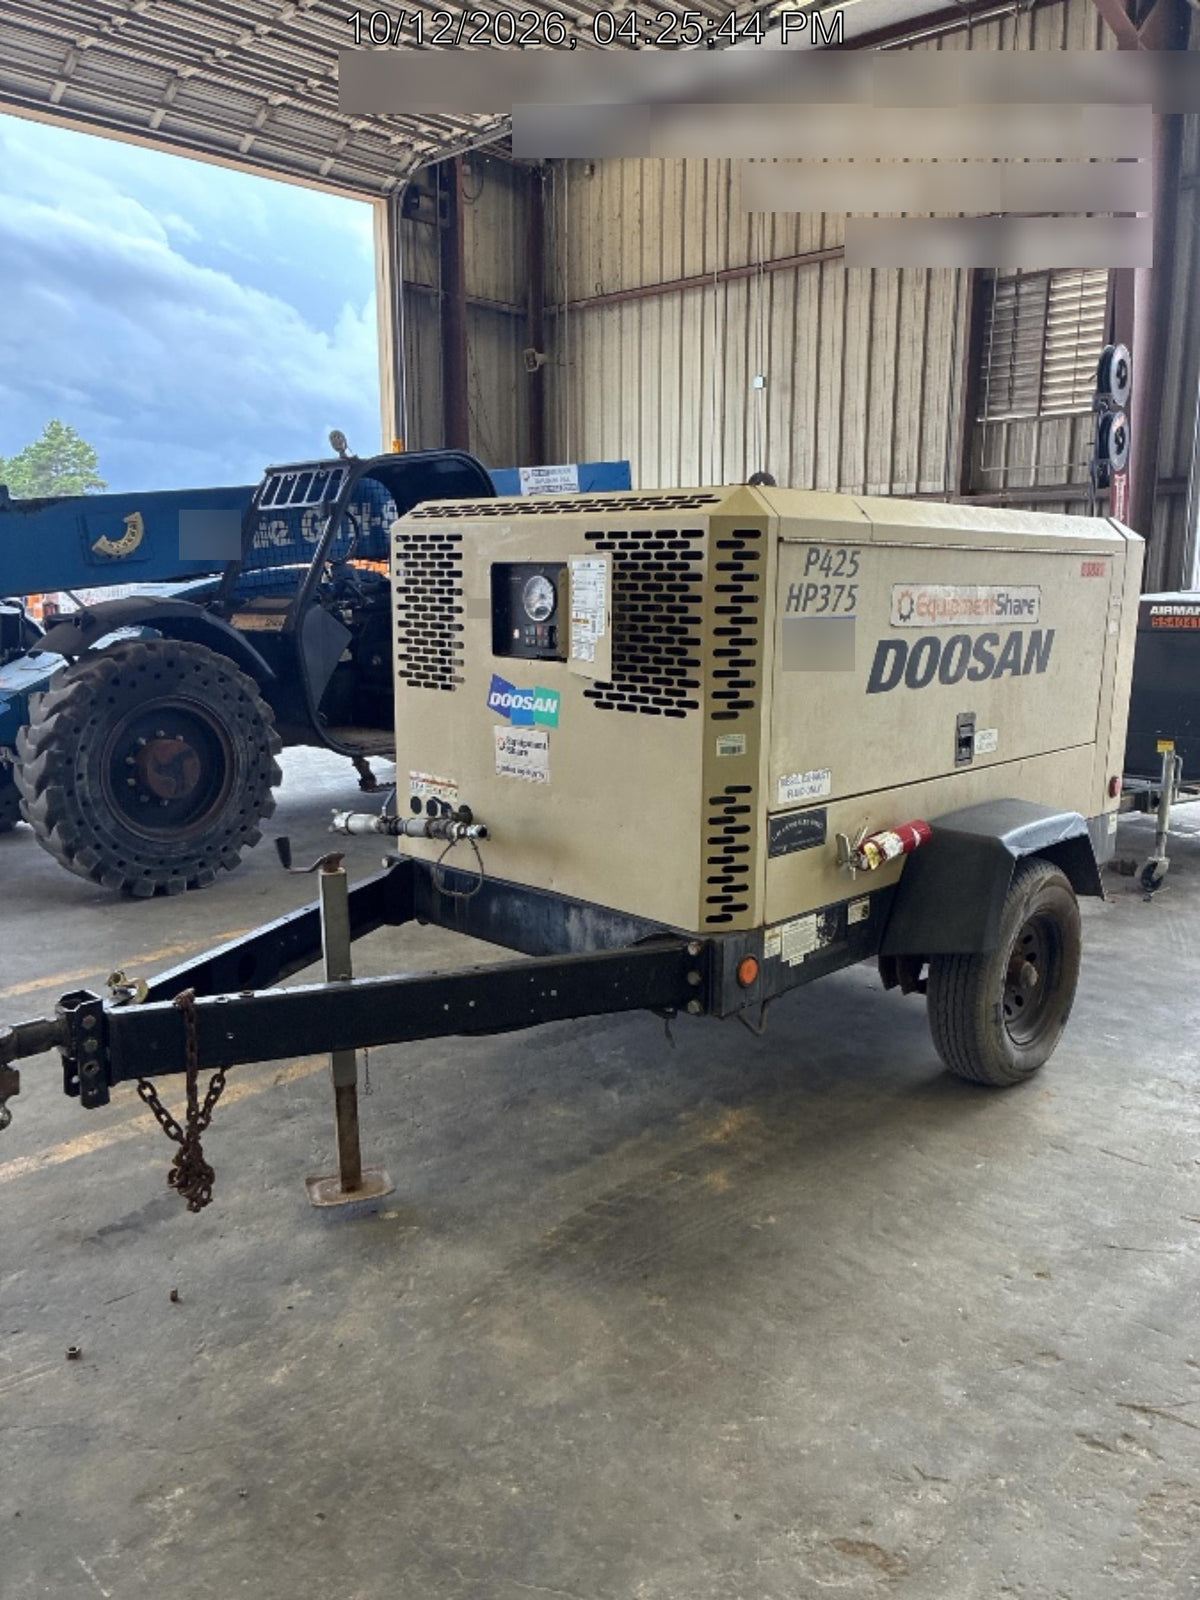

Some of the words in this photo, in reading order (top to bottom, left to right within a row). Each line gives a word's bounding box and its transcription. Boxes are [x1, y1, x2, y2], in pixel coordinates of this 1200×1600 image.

[803, 546, 861, 578] P425
[785, 582, 859, 612] HP375
[916, 592, 1036, 621] EquipmentShare
[866, 628, 1055, 694] DOOSAN
[489, 692, 558, 714] DOOSAN
